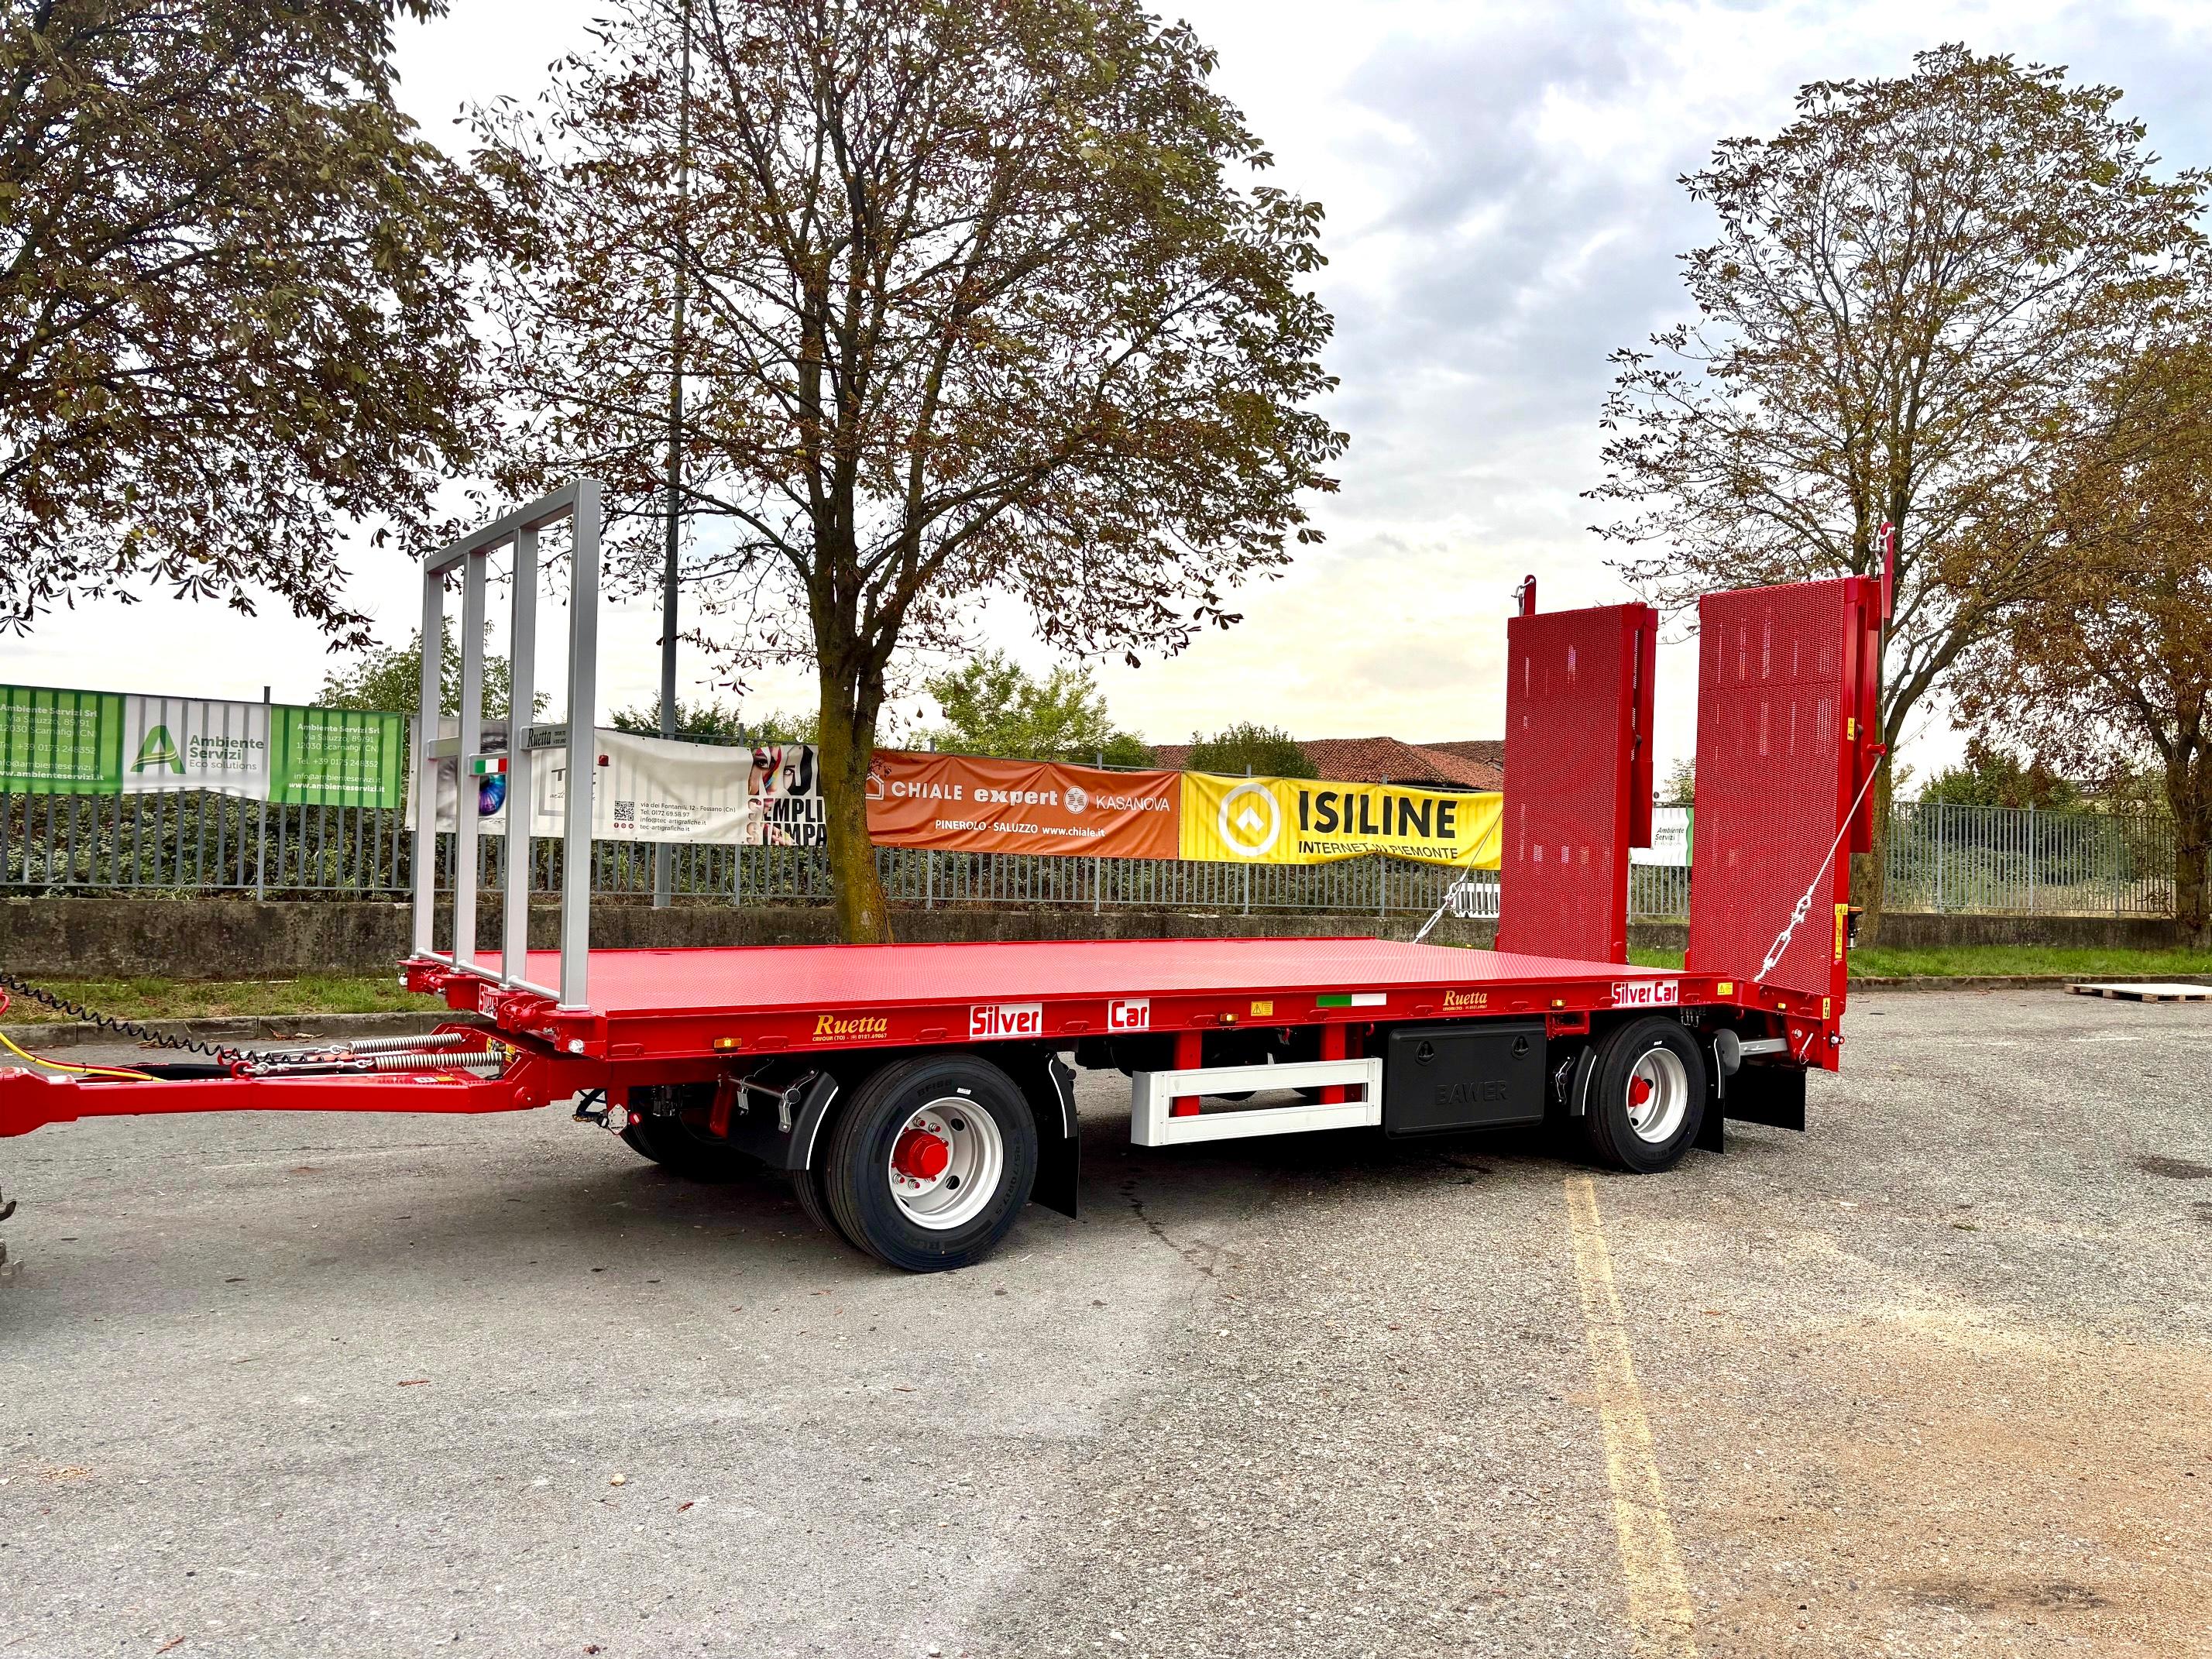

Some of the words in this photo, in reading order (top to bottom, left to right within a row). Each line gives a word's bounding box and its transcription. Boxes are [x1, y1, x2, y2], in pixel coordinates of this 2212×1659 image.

[0, 704, 47, 714] Ambiente
[50, 708, 82, 716] Servizi
[23, 716, 61, 725] Saluzzo,
[64, 719, 91, 727] 89/91
[297, 723, 338, 732] Ambiente
[339, 726, 367, 734] Servizi
[189, 735, 264, 750] Ambiente
[318, 733, 349, 743] Saluzzo,
[527, 728, 551, 747] Ruetta
[62, 745, 95, 754] 248352
[190, 747, 242, 760] Servizi
[0, 760, 98, 771] nfo@ambienteservizi.it
[211, 761, 257, 770] solutions
[294, 774, 382, 783] info@ambienteservizi.it
[289, 782, 385, 792] www.ambienteservizi.it
[891, 781, 962, 801] CHIALE
[974, 788, 1058, 807] expert
[1097, 795, 1170, 812] KASANOVA
[1299, 791, 1458, 838] ISILINE
[746, 822, 828, 846] STAMPA
[935, 819, 987, 831] PINEROLO
[993, 823, 1038, 834] SALUZZO
[1042, 826, 1105, 837] www.chiale.it
[1298, 841, 1369, 854] INTERNET
[1389, 845, 1458, 859] PIEMONTE
[1442, 991, 1487, 1005] Ruetta
[1613, 982, 1651, 1005] Silver
[1654, 981, 1677, 1002] Car
[812, 1015, 888, 1035] Ruetta
[972, 1006, 1039, 1035] Silver
[1111, 1001, 1148, 1028] Car
[1436, 1080, 1506, 1105] BAWER
